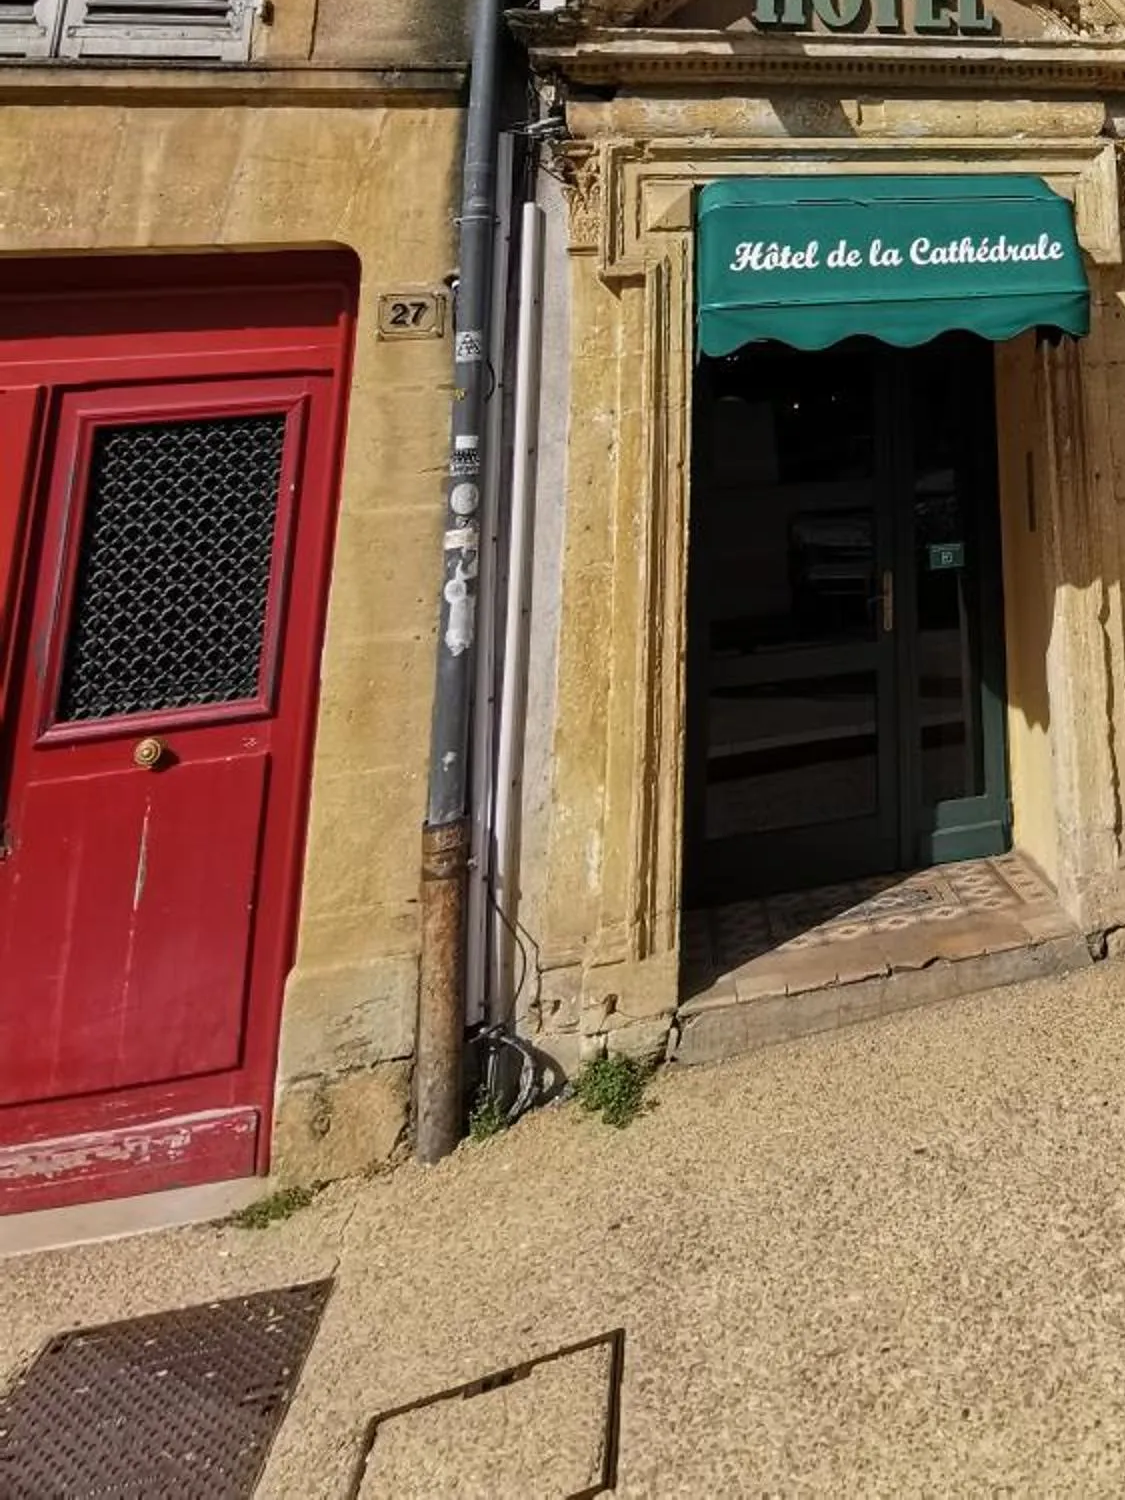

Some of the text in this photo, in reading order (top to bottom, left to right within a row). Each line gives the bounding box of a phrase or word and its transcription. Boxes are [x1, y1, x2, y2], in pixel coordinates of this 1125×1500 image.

[730, 233, 1064, 271] Hôtel de la Cathédrale
[389, 302, 427, 325] 27
